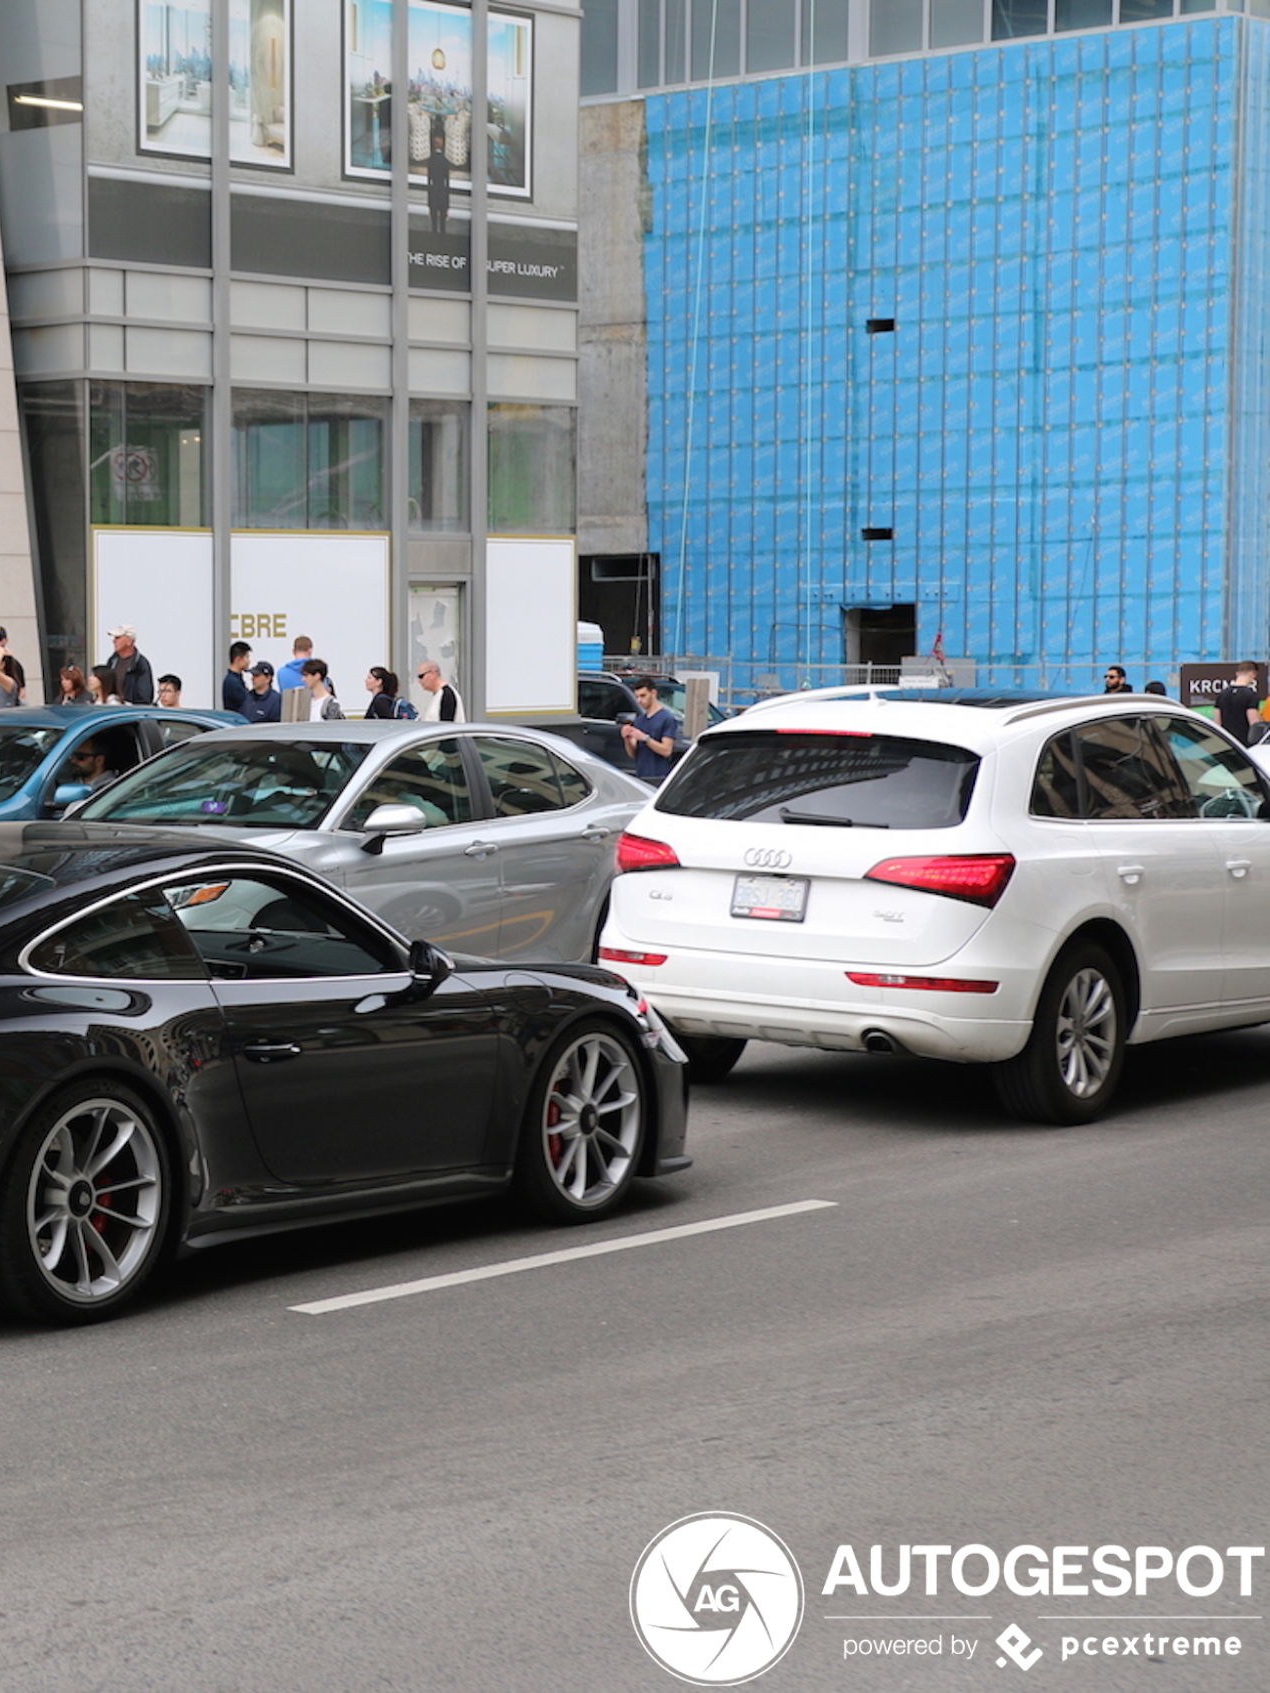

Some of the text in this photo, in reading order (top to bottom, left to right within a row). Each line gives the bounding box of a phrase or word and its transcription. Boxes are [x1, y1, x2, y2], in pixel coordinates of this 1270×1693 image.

[426, 253, 450, 269] RISE
[451, 256, 467, 269] OF
[518, 263, 558, 278] LUXURY
